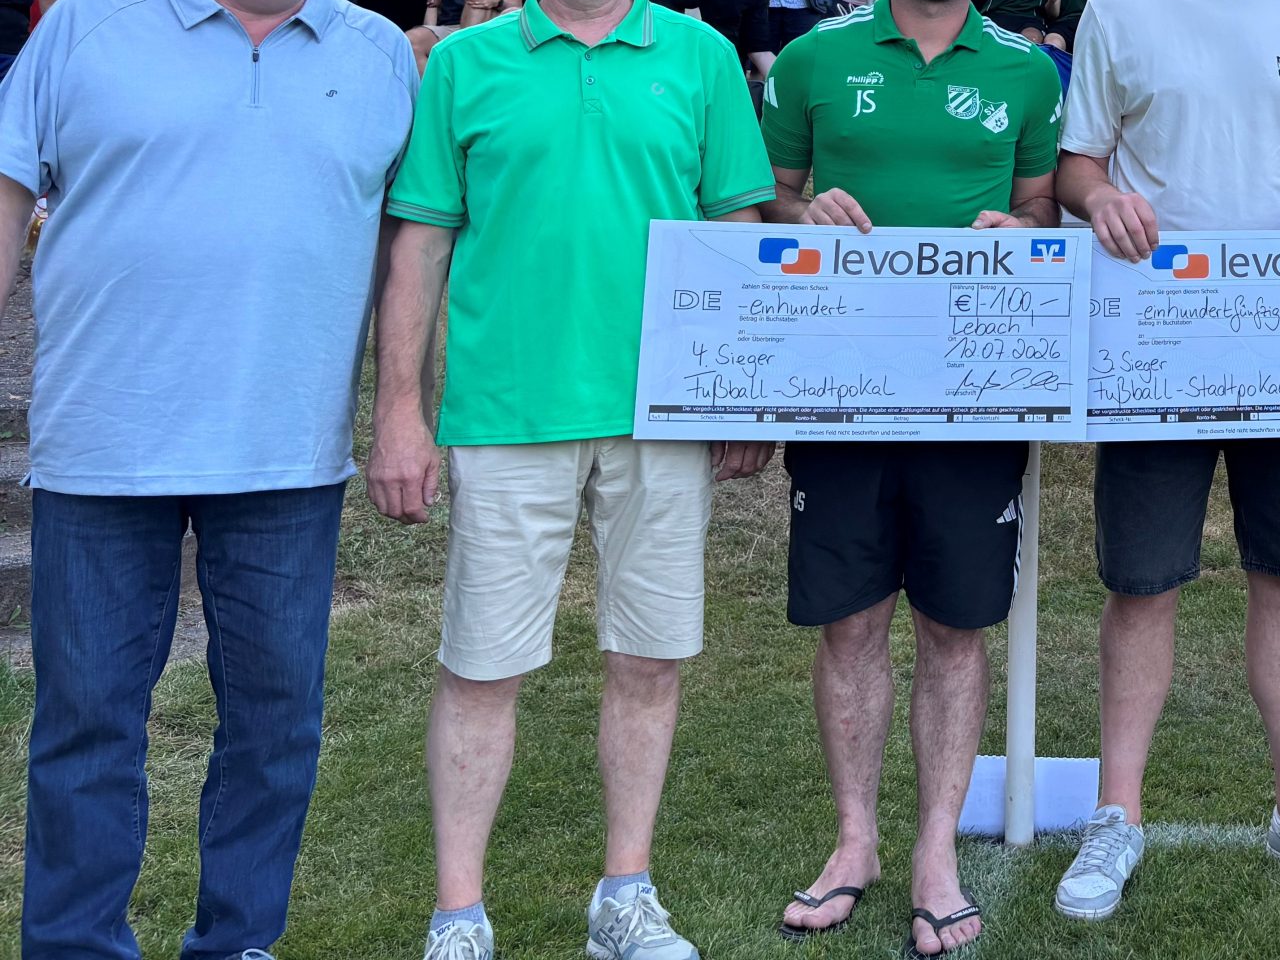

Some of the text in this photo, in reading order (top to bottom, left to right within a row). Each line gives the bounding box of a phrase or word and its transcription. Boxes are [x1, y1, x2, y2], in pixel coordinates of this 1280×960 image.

[846, 75, 878, 85] Philipp
[853, 89, 877, 118] JS
[984, 103, 996, 116] SV
[832, 238, 1015, 277] levoBank
[809, 284, 830, 292] Scheck
[673, 289, 722, 311] DE
[954, 294, 972, 312] €
[952, 316, 1020, 336] Lebach
[751, 335, 785, 343] Überbringer
[944, 336, 1061, 361] 12.07.2026
[1150, 338, 1182, 346] Überbringer
[715, 343, 776, 378] Sieger
[1092, 349, 1168, 384] 3. Sieger
[793, 489, 806, 512] JS
